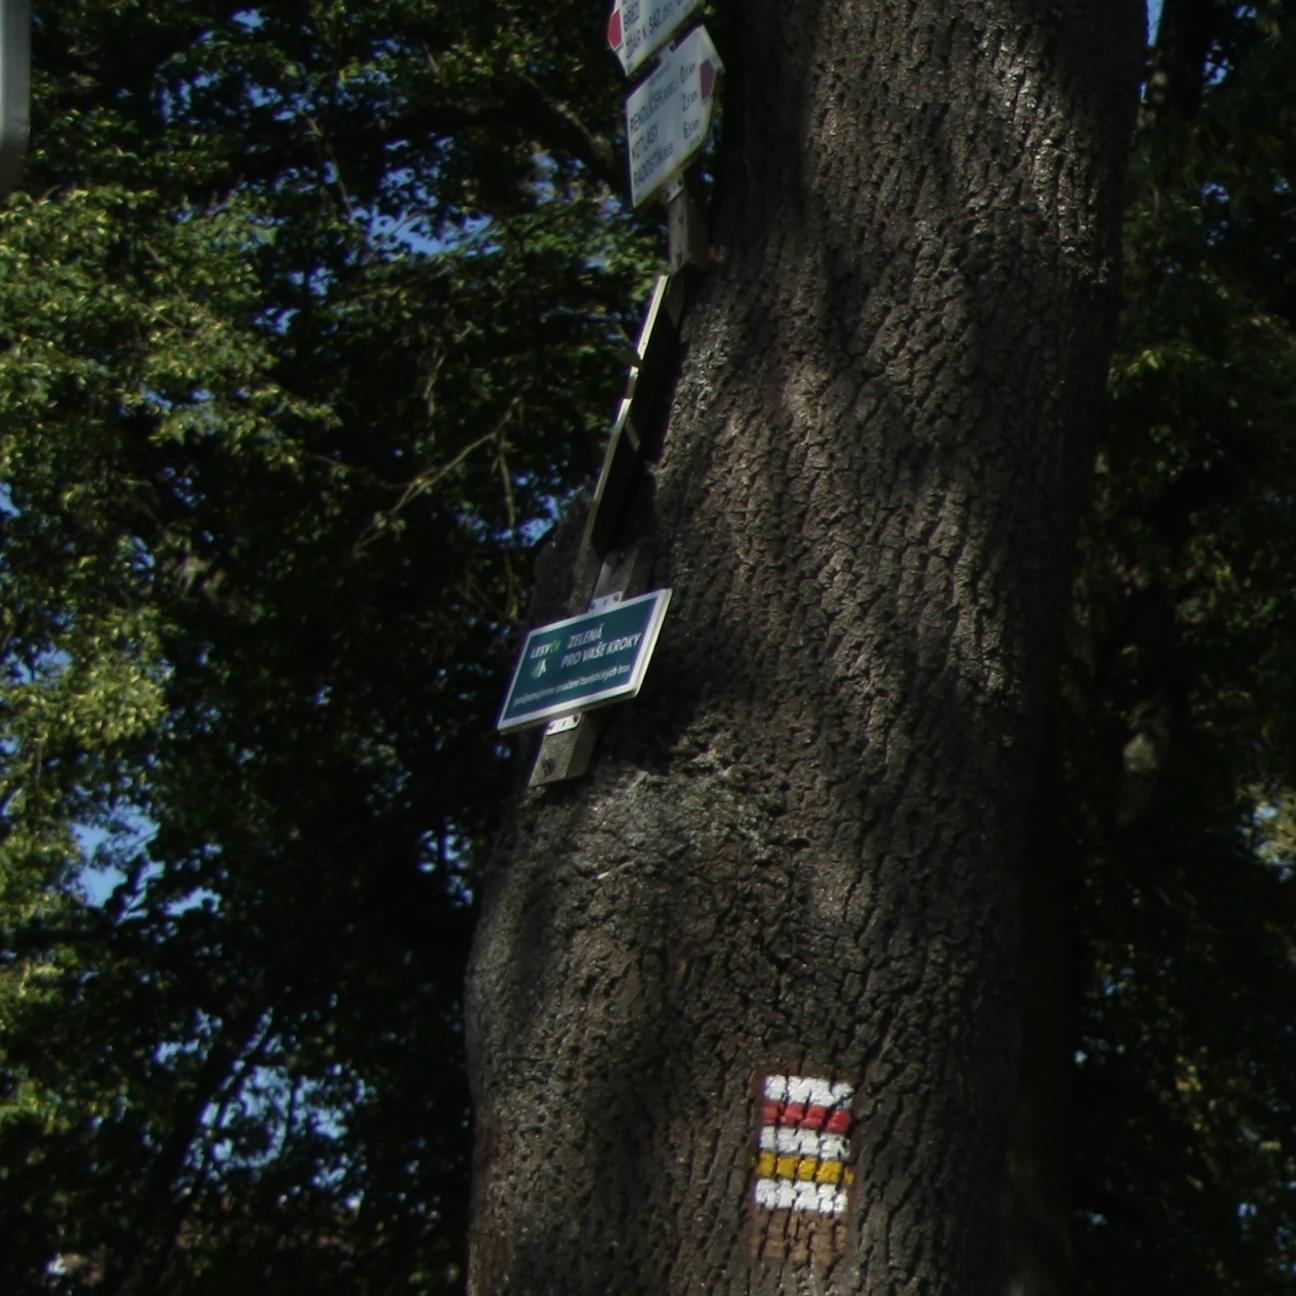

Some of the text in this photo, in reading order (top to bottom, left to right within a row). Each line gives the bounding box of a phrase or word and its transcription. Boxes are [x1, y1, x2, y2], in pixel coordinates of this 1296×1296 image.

[561, 632, 643, 669] PRO VAŠE KROKY
[567, 622, 605, 649] ZELENÁ
